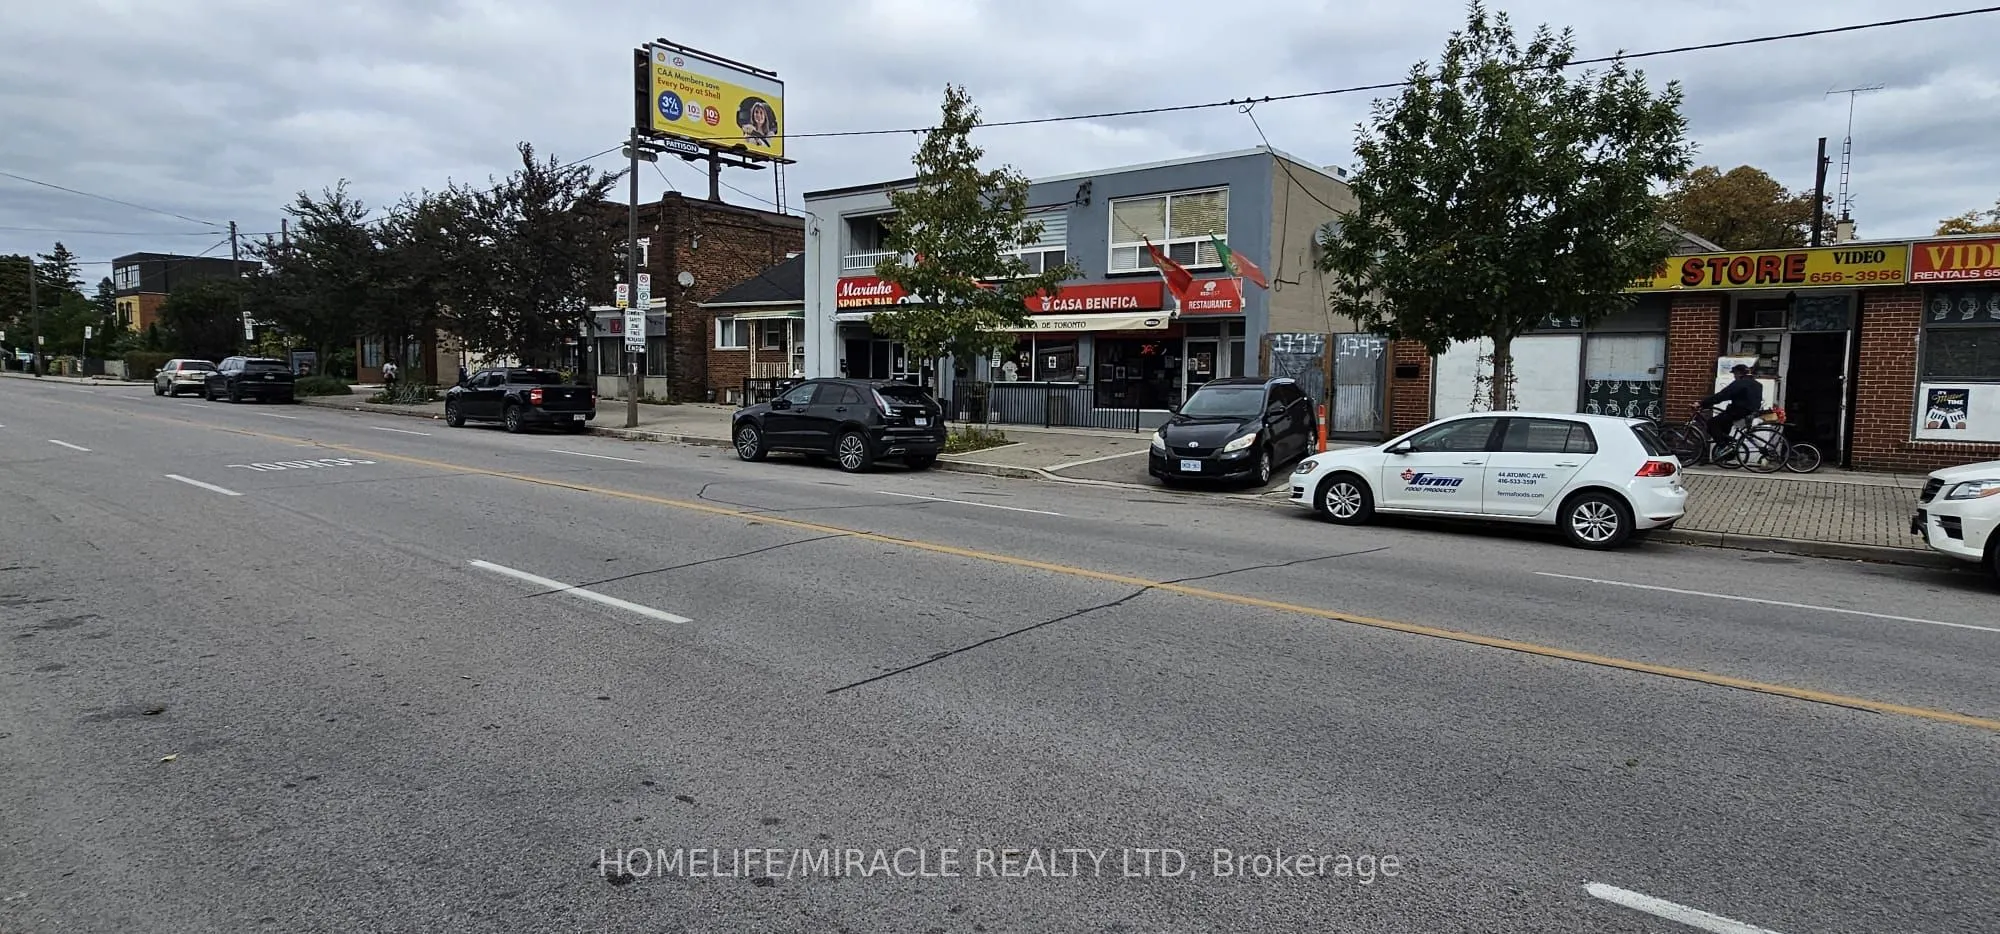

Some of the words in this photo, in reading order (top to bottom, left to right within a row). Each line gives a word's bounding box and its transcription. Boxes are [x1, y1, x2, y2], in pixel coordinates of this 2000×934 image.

[657, 67, 673, 78] CAA
[675, 72, 704, 87] Members
[657, 77, 677, 90] Every
[680, 83, 695, 94] Day
[705, 90, 721, 100] Shell
[666, 140, 697, 152] PATTISON
[1833, 250, 1886, 265] VIDEO
[1681, 253, 1808, 286] STORE
[1809, 269, 1901, 283] 656-3956
[1914, 269, 1980, 280] RENTALS
[838, 280, 893, 297] Marinho
[838, 298, 873, 308] SPORTS
[874, 297, 893, 305] BAR
[1053, 299, 1083, 311] CASA
[1086, 296, 1138, 310] BENFICA
[1188, 300, 1233, 310] RESTAURANTE
[1041, 321, 1050, 329] DE
[1053, 321, 1087, 329] TORONTO
[1274, 333, 1324, 353] 1747
[1340, 338, 1384, 360] 1747
